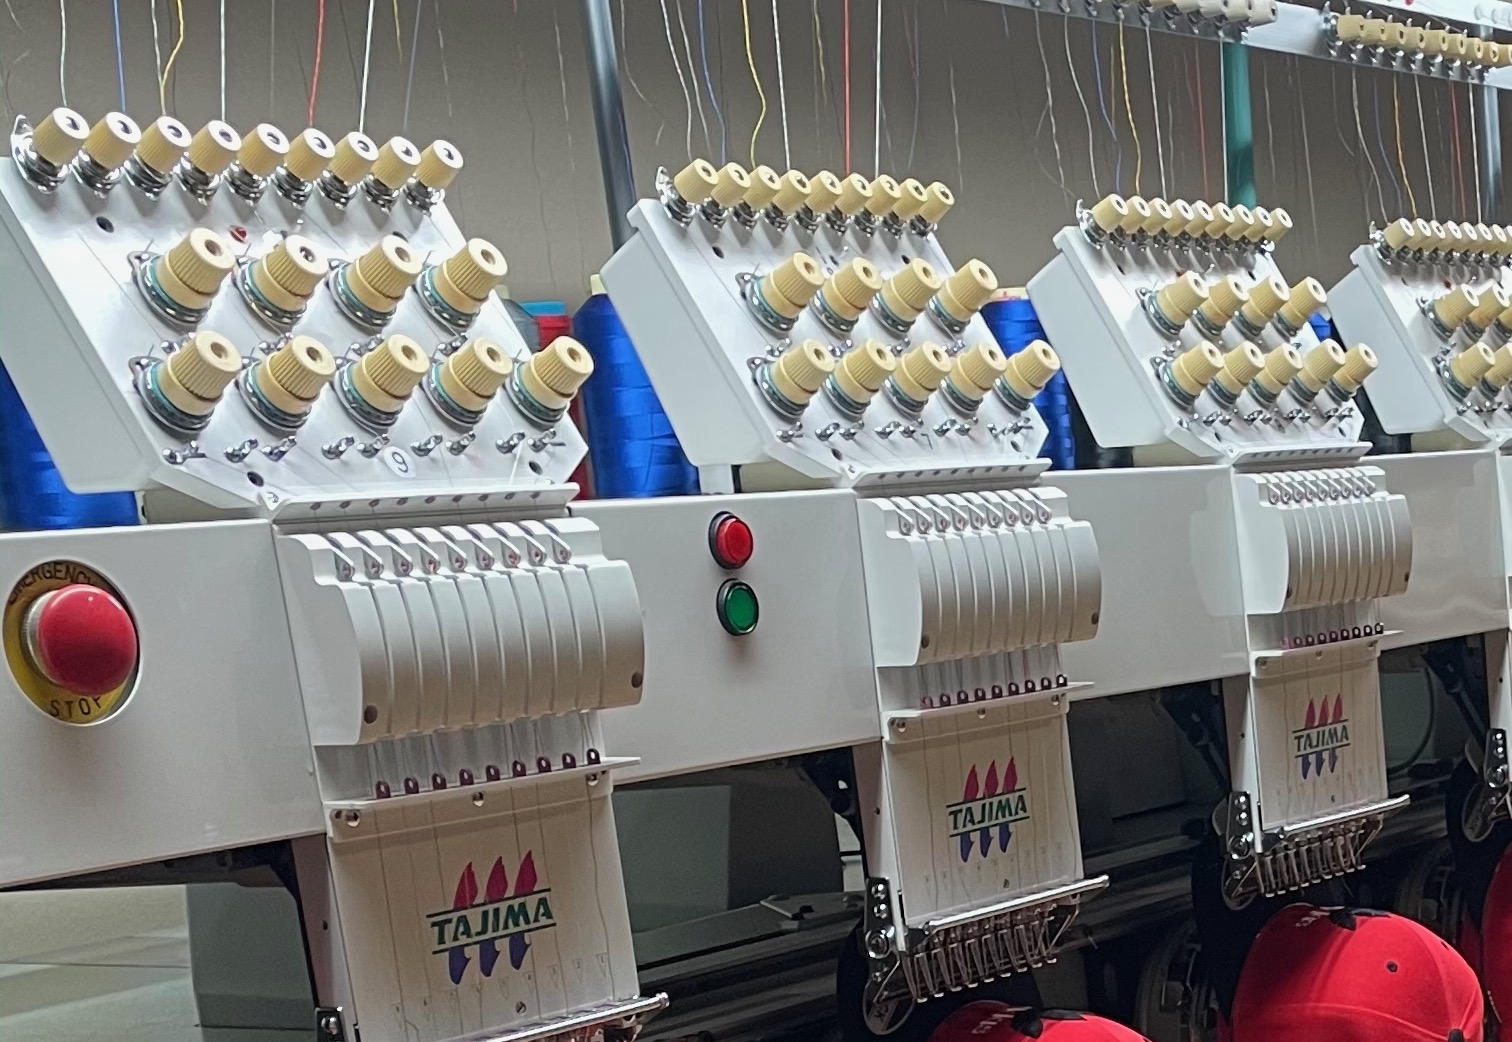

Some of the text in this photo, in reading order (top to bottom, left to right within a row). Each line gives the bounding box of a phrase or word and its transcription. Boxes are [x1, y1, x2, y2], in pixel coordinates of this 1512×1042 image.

[9, 561, 92, 605] MERGENC
[1294, 724, 1350, 752] TAJIMA
[948, 794, 1028, 831] TAJIMA
[431, 897, 554, 946] TAJIMA
